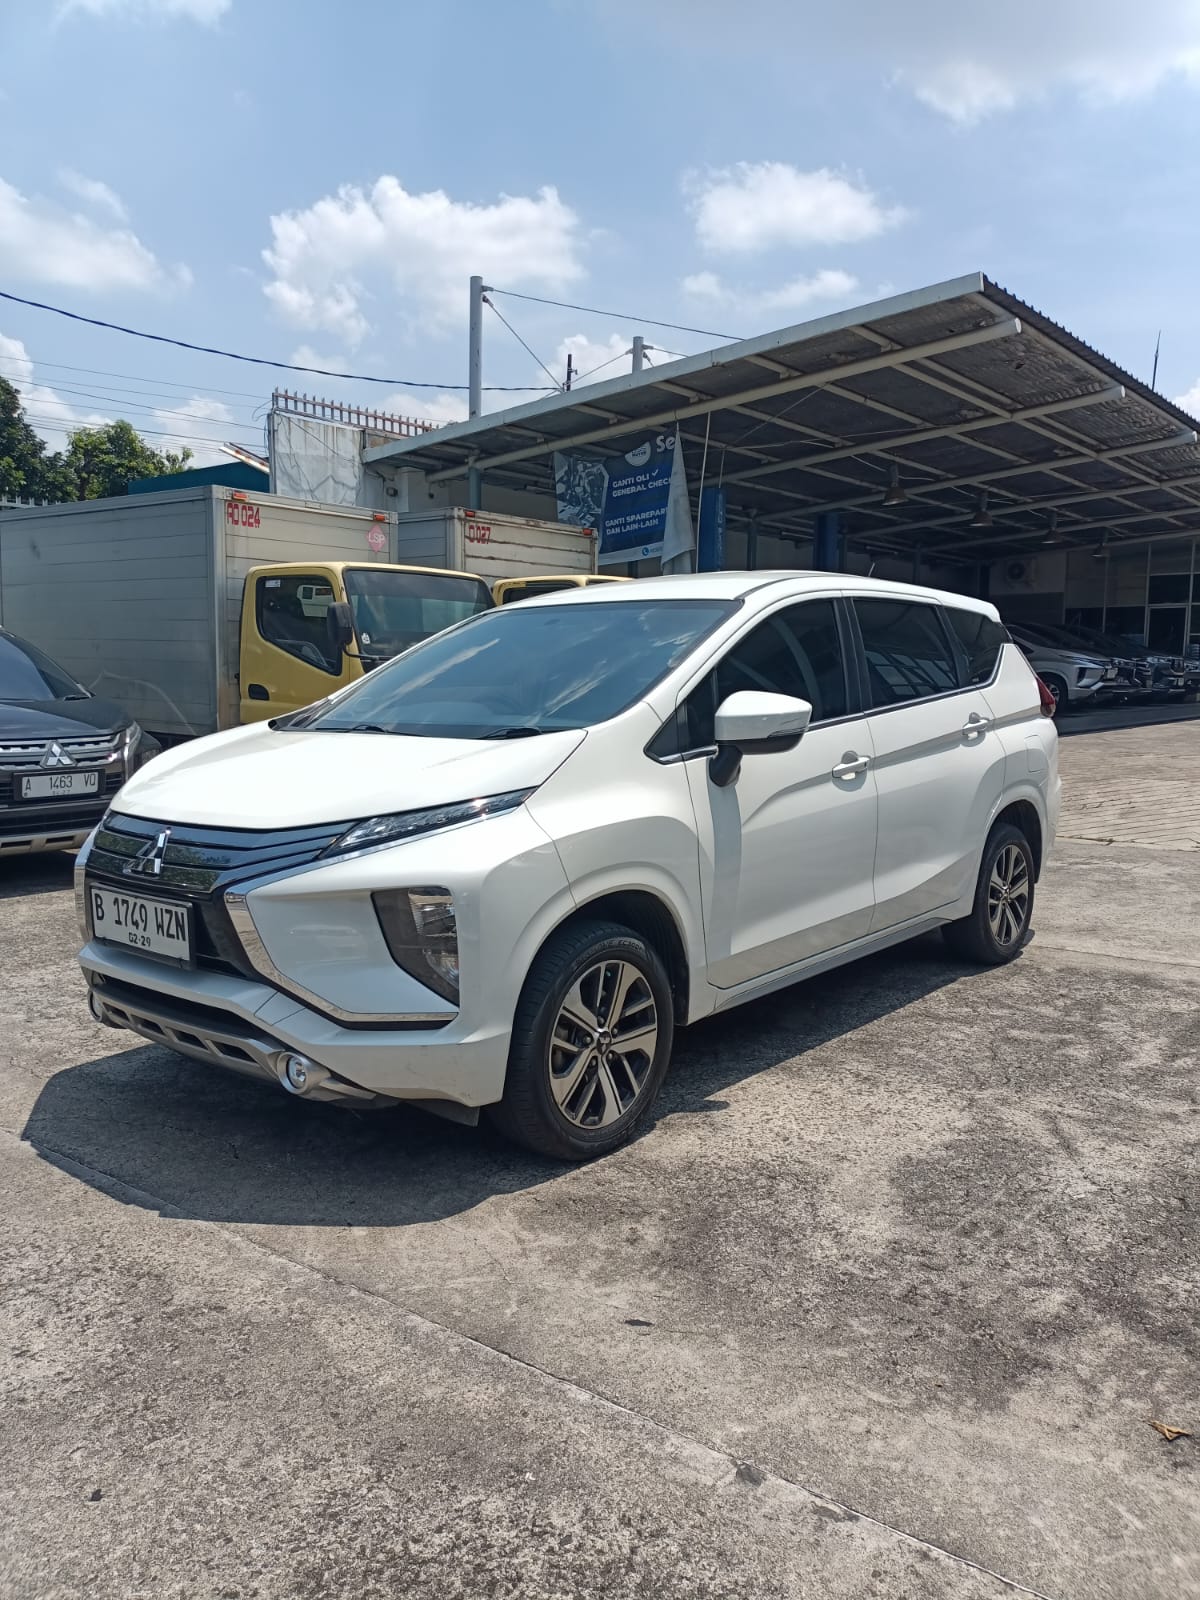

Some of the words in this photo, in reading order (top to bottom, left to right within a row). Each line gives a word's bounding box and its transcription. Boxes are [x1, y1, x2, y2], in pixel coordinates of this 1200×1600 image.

[612, 477, 634, 488] GANTI
[636, 473, 650, 482] OLI
[612, 484, 647, 497] GENERAL
[605, 517, 625, 527] GANTI
[606, 526, 621, 535] DAN
[622, 518, 659, 532] LAIN-LAIN
[25, 778, 31, 791] A
[49, 775, 73, 790] 1463
[94, 893, 104, 921] B
[113, 897, 148, 932] 1749
[154, 906, 186, 941] WZN
